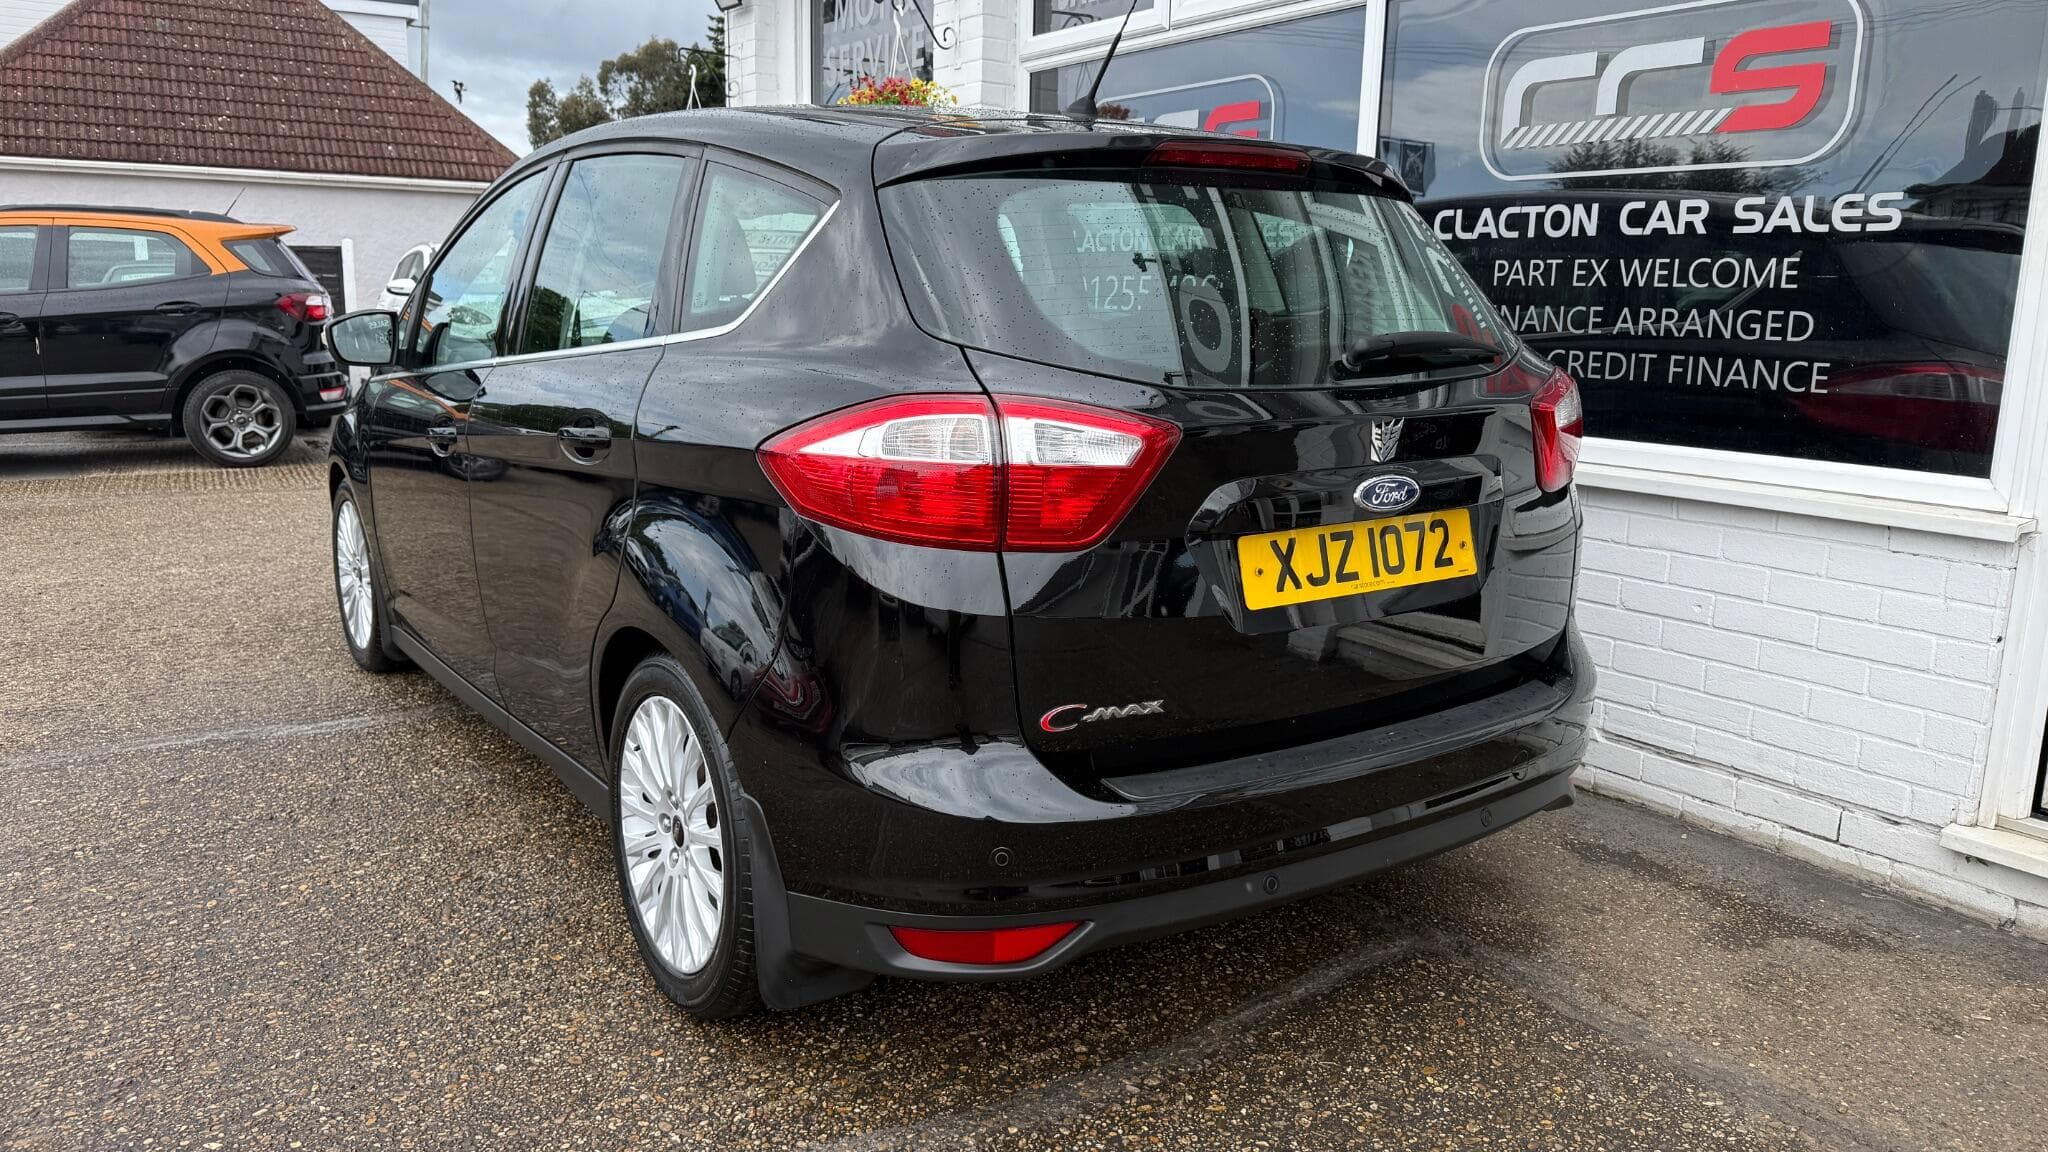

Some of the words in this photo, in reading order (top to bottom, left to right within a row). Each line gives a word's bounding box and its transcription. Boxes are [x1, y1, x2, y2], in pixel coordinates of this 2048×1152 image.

[823, 24, 926, 87] SERVICE
[1500, 20, 1832, 149] CCS
[1433, 202, 1599, 240] CLACTON
[1619, 199, 1709, 236] CAR
[1733, 191, 1905, 234] SALES
[1073, 226, 1150, 253] ACTON
[1493, 259, 1563, 287] PART
[1572, 259, 1610, 287] EX
[1619, 257, 1800, 289] WELCOME
[1494, 304, 1604, 334] NANCE
[1613, 307, 1815, 342] ARRANGED
[1668, 356, 1831, 395] FINANCE
[1372, 483, 1407, 505] Ford
[1269, 530, 1360, 593] XJZ
[1367, 518, 1454, 578] 1072
